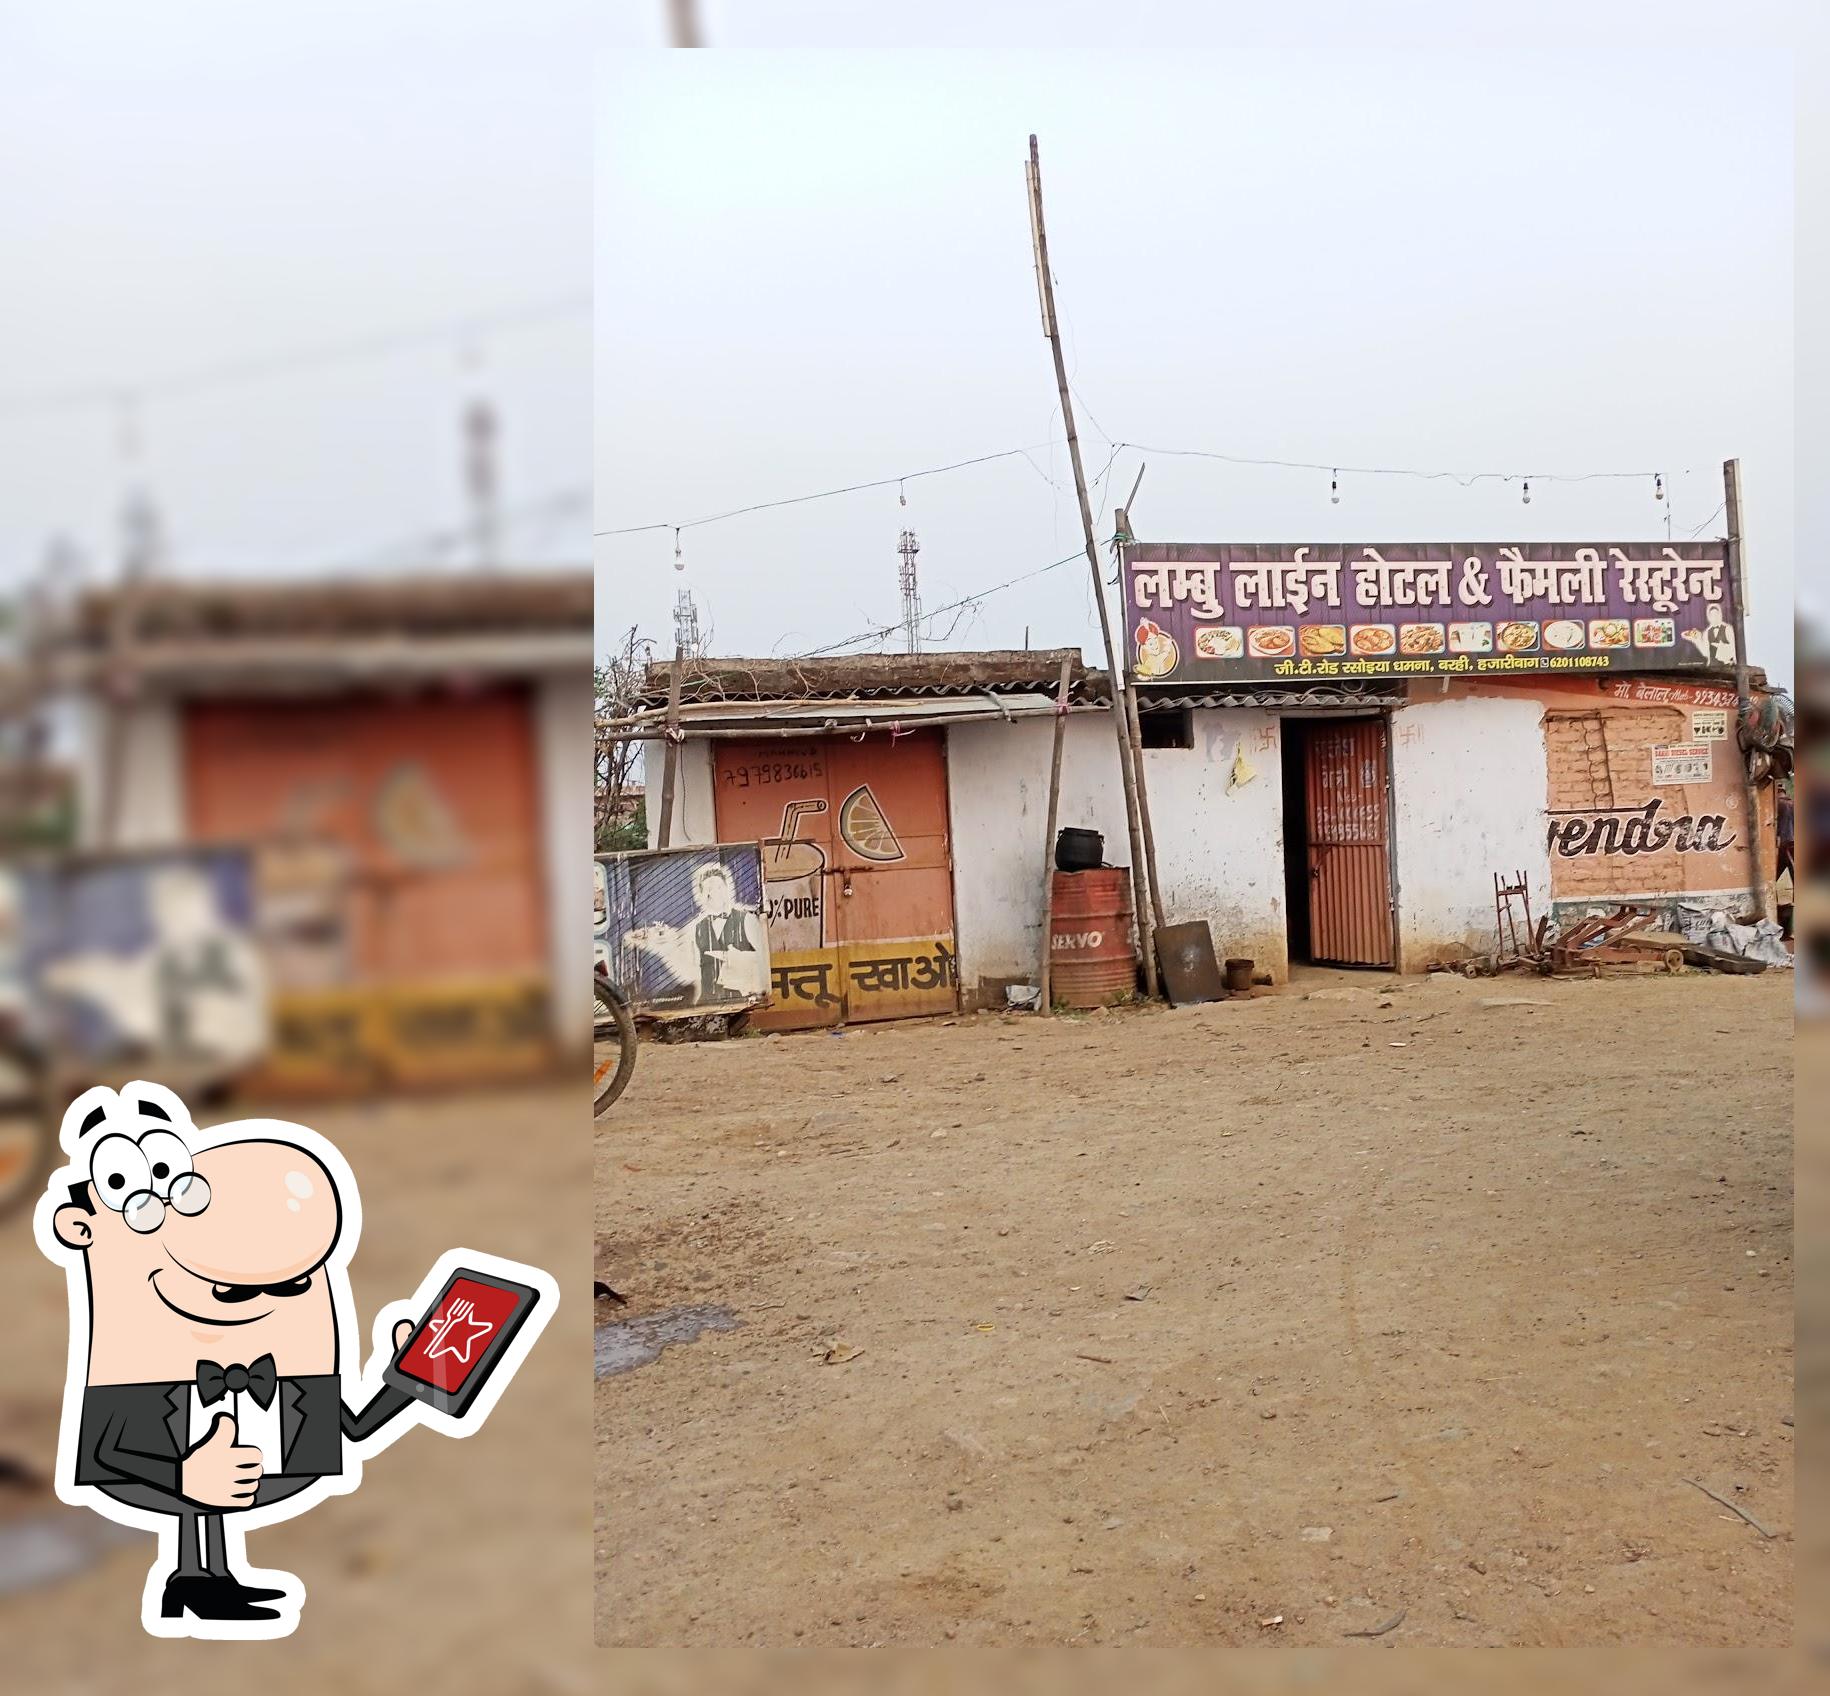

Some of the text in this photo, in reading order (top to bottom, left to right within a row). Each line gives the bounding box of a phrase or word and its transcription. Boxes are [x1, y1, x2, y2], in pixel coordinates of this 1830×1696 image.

[1131, 561, 1224, 619] लम्बु
[1229, 547, 1341, 615] लाईन
[1350, 547, 1452, 606] होटल
[1458, 556, 1493, 605] &
[1496, 547, 1607, 604] फैमली
[1550, 656, 1609, 668] 6201108743
[784, 897, 819, 920] PURE
[1051, 931, 1103, 951] SERVO
